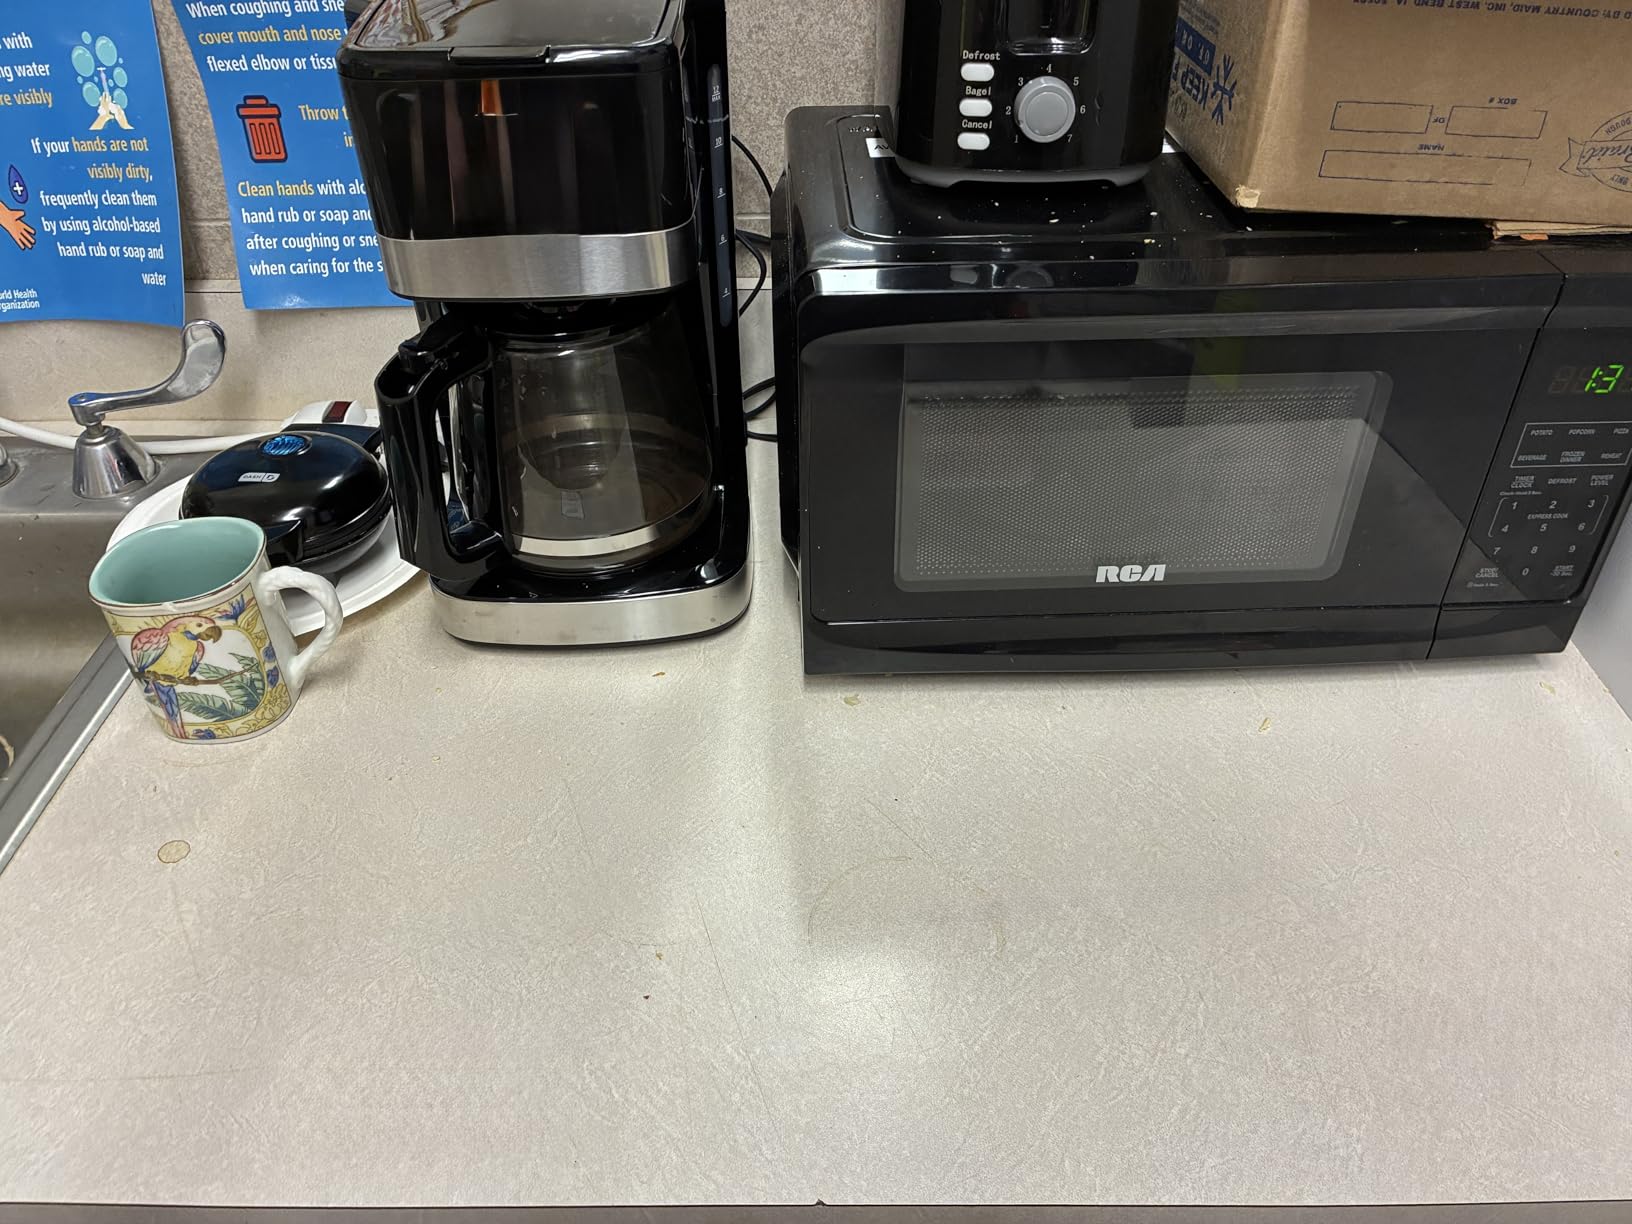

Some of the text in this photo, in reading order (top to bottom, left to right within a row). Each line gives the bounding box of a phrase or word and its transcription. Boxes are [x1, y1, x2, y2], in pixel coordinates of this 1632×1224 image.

[185, 2, 227, 18] When
[229, 0, 291, 19] coughing
[294, 0, 319, 12] and
[1447, 0, 1480, 10] WEST
[1484, 2, 1506, 12] INC.
[1510, 3, 1541, 13] MAID,
[1544, 6, 1600, 17] COUNTRY
[198, 25, 342, 45] cover mouth and nose
[2, 31, 33, 50] with
[962, 50, 1001, 61] Defrost
[206, 54, 248, 72] flexed
[250, 54, 289, 71] elbow
[293, 57, 307, 70] or
[1045, 63, 1052, 73] 4
[17, 62, 51, 77] water
[1017, 77, 1024, 87] 3
[1073, 76, 1080, 86] 5
[712, 85, 720, 94] 12
[965, 86, 992, 96] Bagel
[14, 88, 53, 108] visibly
[1497, 96, 1518, 105] BOX
[298, 105, 339, 121] Throw
[1005, 105, 1012, 115] 2
[1079, 105, 1086, 115] 6
[961, 119, 993, 130] Cancel
[715, 136, 722, 146] 10
[1014, 134, 1019, 143] 1
[1067, 133, 1073, 143] 7
[30, 136, 149, 157] If your hands are not
[1417, 143, 1446, 152] NAME
[87, 162, 153, 183] visibly dirty,
[237, 181, 274, 197] Clean
[276, 180, 314, 196] hands
[317, 180, 346, 195] with
[39, 189, 157, 209] frequently clean them
[241, 207, 274, 223] hand
[278, 206, 299, 222] rub
[302, 210, 316, 222] or
[319, 209, 349, 225] soap
[41, 215, 161, 235] by using alcohol-based
[246, 234, 278, 250] after
[281, 232, 339, 252] coughing
[342, 235, 355, 247] or
[57, 242, 164, 262] hand rub or soap and
[249, 260, 286, 276] when
[289, 259, 329, 277] caring
[331, 257, 349, 273] for
[352, 257, 374, 272] the
[142, 272, 167, 286] water
[13, 288, 38, 299] Health
[1511, 501, 1518, 510] 1
[1549, 501, 1557, 509] 2
[1587, 500, 1595, 508] 3
[1501, 524, 1509, 532] 4
[1539, 523, 1548, 532] 5
[1577, 522, 1586, 531] 6
[1493, 547, 1501, 555] 7
[1530, 546, 1538, 554] 8
[1568, 545, 1576, 553] 9
[1096, 564, 1167, 583] RCA
[1522, 567, 1530, 576] 0
